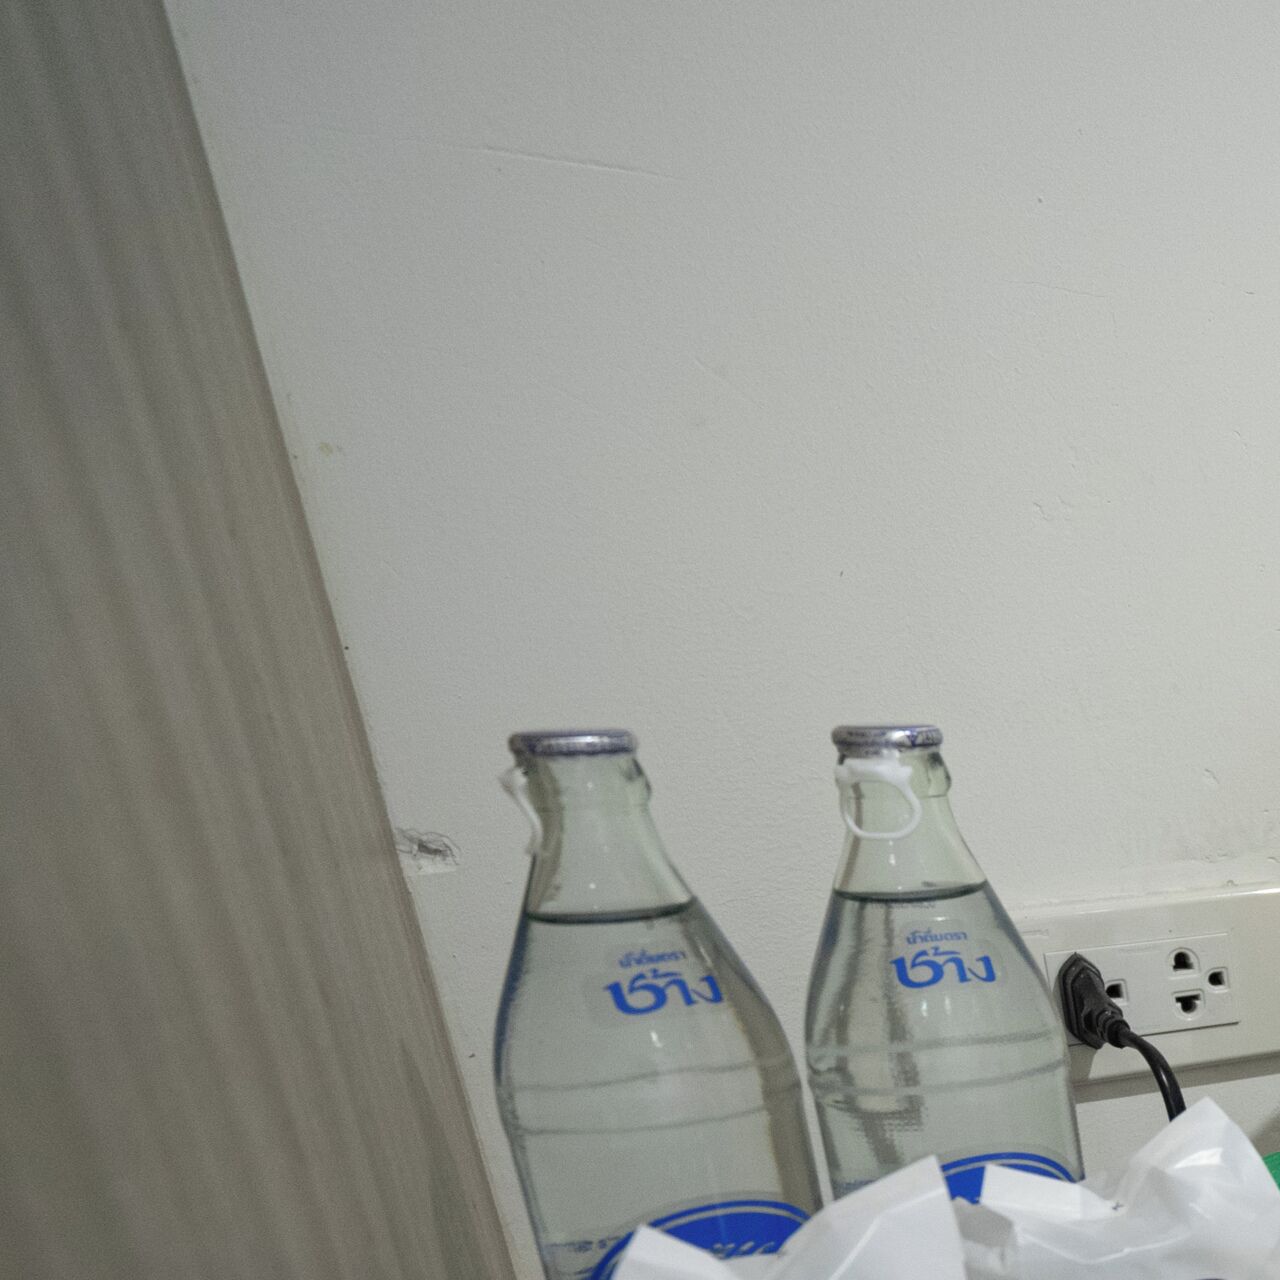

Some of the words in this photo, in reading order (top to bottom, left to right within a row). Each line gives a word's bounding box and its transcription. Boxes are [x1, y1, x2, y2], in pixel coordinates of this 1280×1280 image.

[906, 928, 968, 945] น้ำดื่มตรา
[889, 946, 996, 989] ช้าง
[603, 968, 723, 1015] ช้าง
